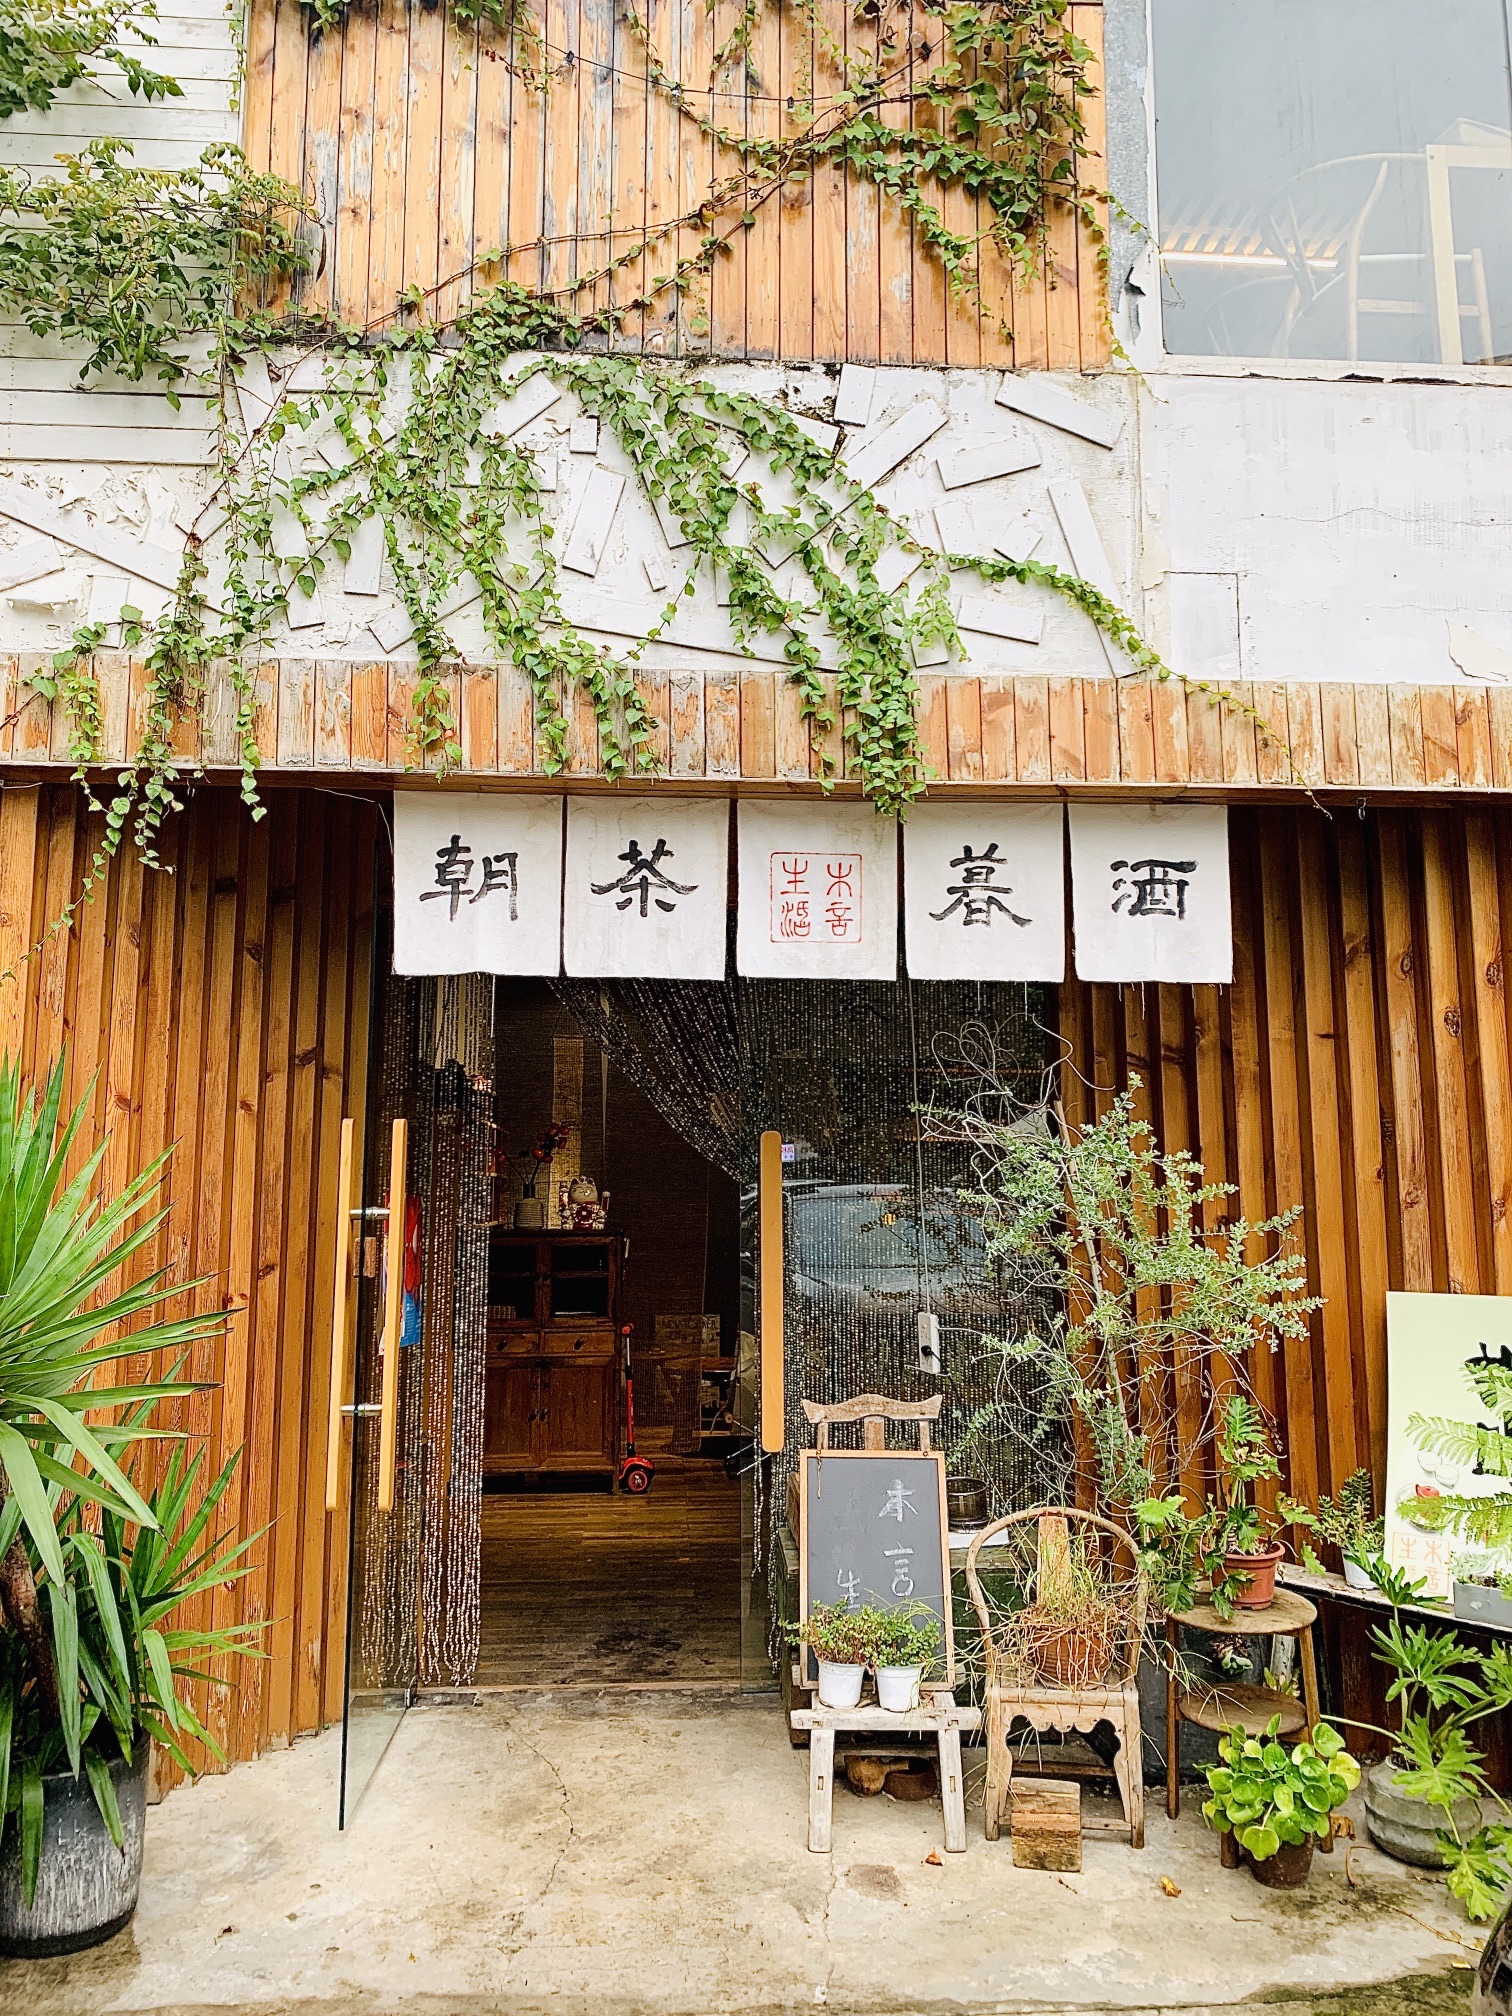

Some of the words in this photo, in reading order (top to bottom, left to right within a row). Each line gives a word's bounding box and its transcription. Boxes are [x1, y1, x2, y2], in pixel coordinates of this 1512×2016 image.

[419, 834, 518, 922] 朝
[591, 838, 699, 918] 茶
[928, 843, 1033, 927] 暮
[1110, 859, 1199, 920] 酒
